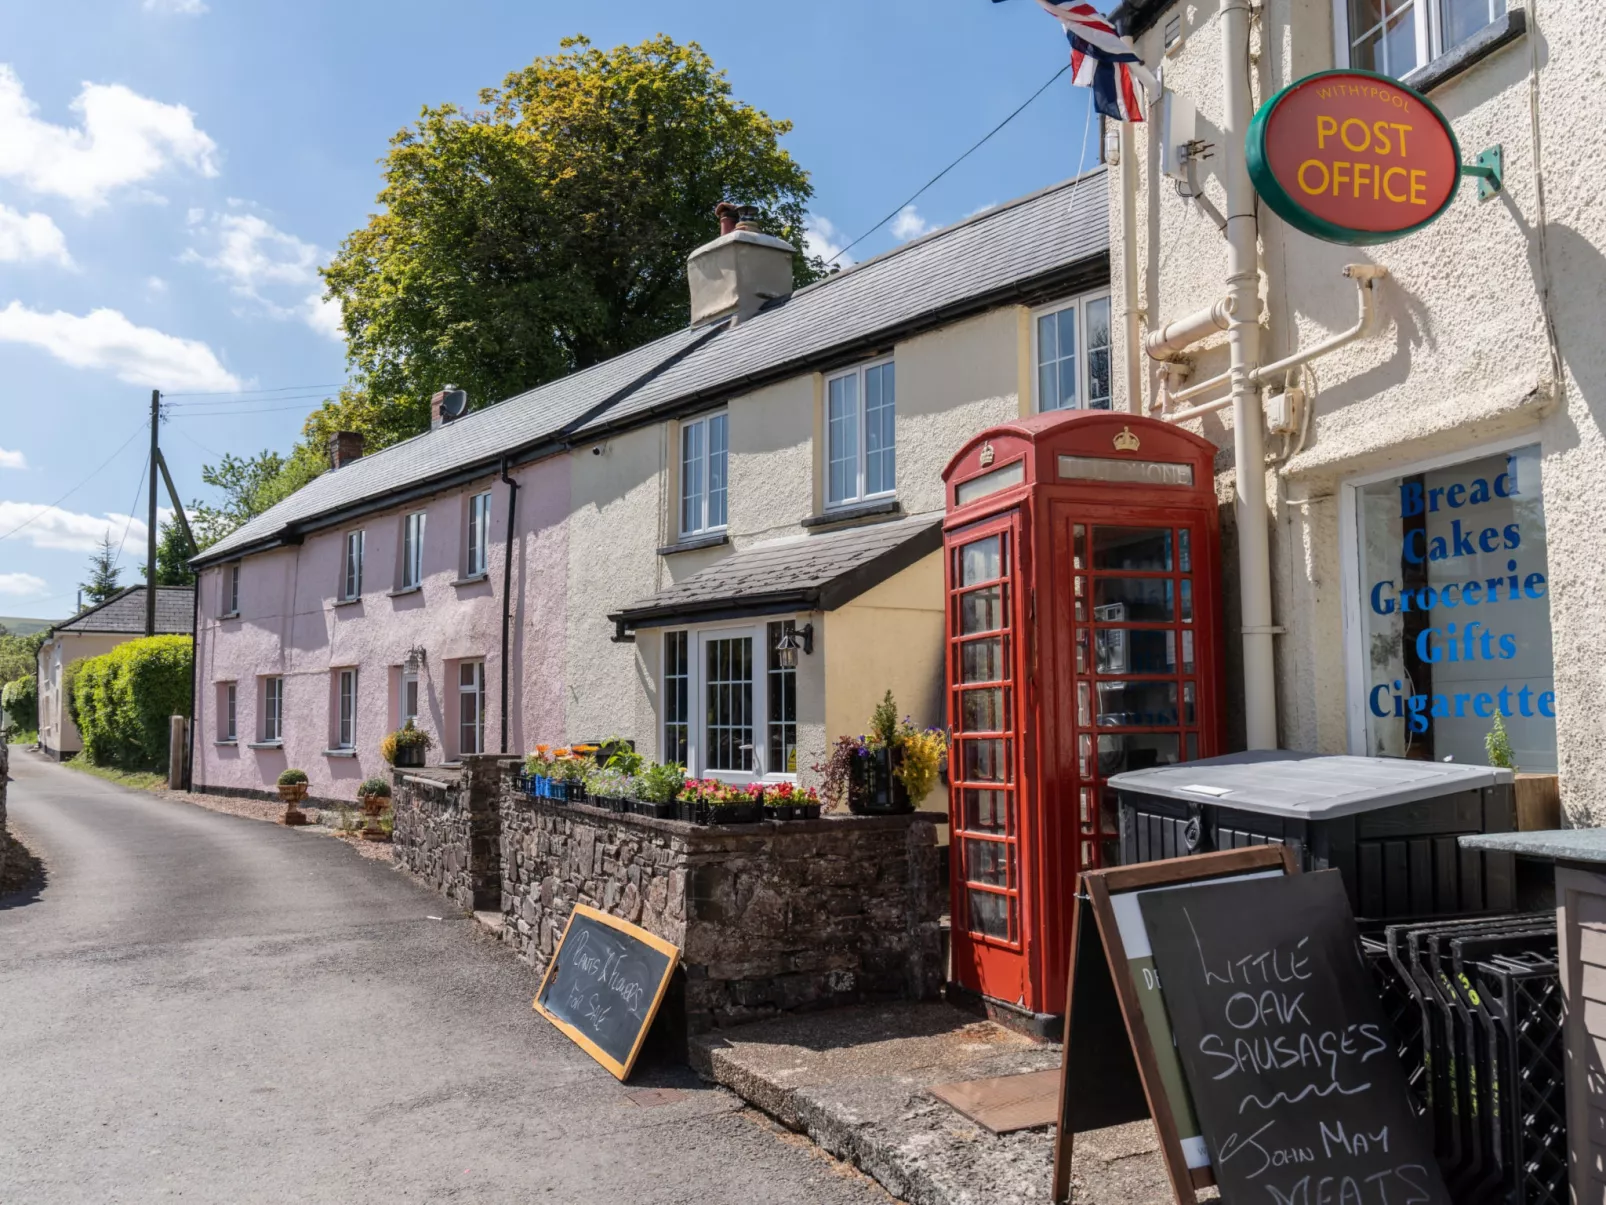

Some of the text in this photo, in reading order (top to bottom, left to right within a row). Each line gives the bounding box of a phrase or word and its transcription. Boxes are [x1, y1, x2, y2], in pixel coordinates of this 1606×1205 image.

[1316, 84, 1410, 113] WITHYPOOL
[1316, 115, 1413, 158] POST
[1297, 158, 1427, 206] OFFICE
[1399, 454, 1522, 520] Bread
[1401, 519, 1521, 565] Cakes
[1370, 559, 1547, 616] Grocerie
[1415, 621, 1517, 665] Gifts
[1183, 907, 1313, 986] LITTLE
[1225, 990, 1311, 1030] OAK
[1199, 1024, 1387, 1081] SAUSAGES
[1319, 1120, 1389, 1159] MAY
[1265, 1164, 1431, 1205] MEATS
